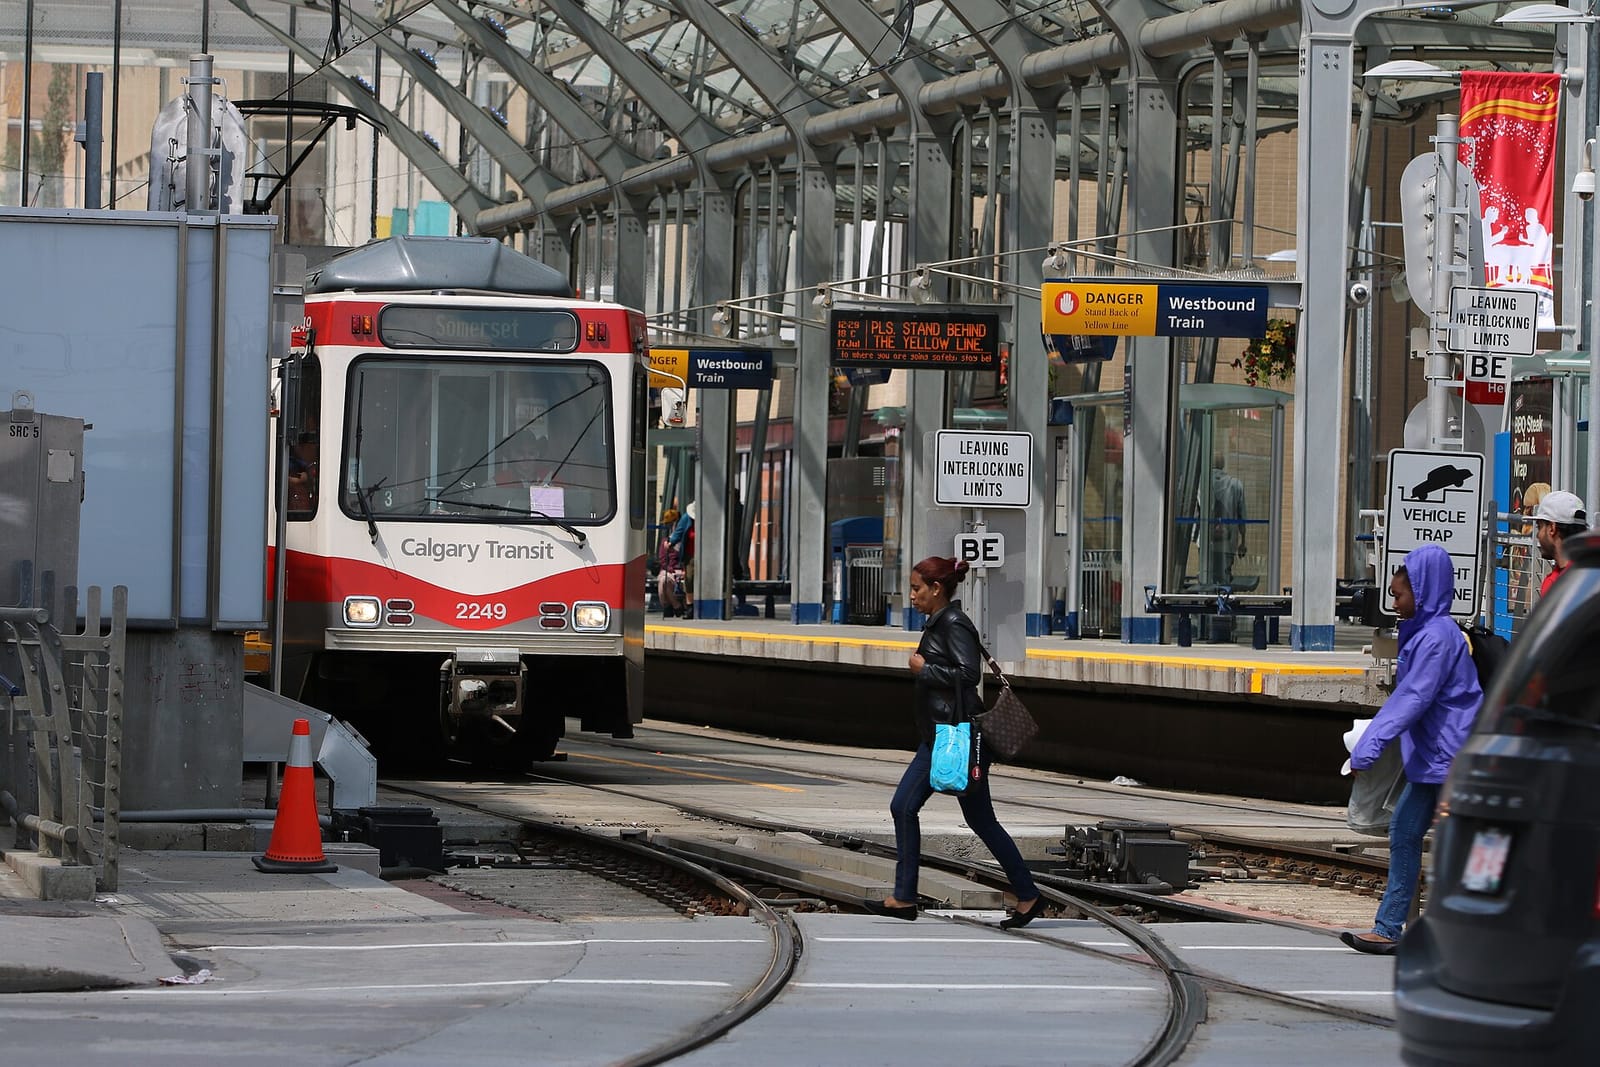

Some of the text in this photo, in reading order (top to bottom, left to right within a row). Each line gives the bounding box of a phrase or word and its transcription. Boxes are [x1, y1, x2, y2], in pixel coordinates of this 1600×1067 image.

[1085, 292, 1144, 305] DANGER
[1169, 297, 1255, 312] Westbound
[1471, 295, 1517, 310] LEAVING
[1085, 307, 1139, 317] Stand Back of
[436, 316, 519, 339] Somerset
[871, 320, 987, 338] PLS. STAND BEHIND
[1084, 321, 1129, 330] Yellow Line
[1168, 315, 1205, 329] Train
[1456, 313, 1530, 330] INTERLOCKING
[873, 335, 984, 351] THE YELLOW LINE.
[1473, 332, 1509, 347] LIMITS
[649, 356, 678, 365] NGER
[841, 351, 849, 359] to
[852, 351, 873, 360] where
[877, 352, 890, 361] you
[910, 352, 929, 361] going
[961, 353, 978, 362] stay
[696, 359, 763, 370] Westbound
[1471, 355, 1507, 379] BE
[696, 372, 724, 383] Train
[1488, 383, 1506, 393] He
[9, 425, 39, 438] SRC 5
[1514, 414, 1544, 437] BBQ Steak
[960, 440, 1009, 456] LEAVING
[1530, 436, 1536, 455] &
[943, 460, 1024, 477] INTERLOCKING
[1513, 459, 1528, 480] Wrap
[963, 482, 1002, 497] LIMITS
[384, 490, 393, 507] 3
[1403, 508, 1466, 524] VEHICLE
[1413, 528, 1453, 542] TRAP
[400, 537, 554, 563] Calgary Transit
[961, 538, 999, 561] BE
[455, 602, 507, 620] 2249
